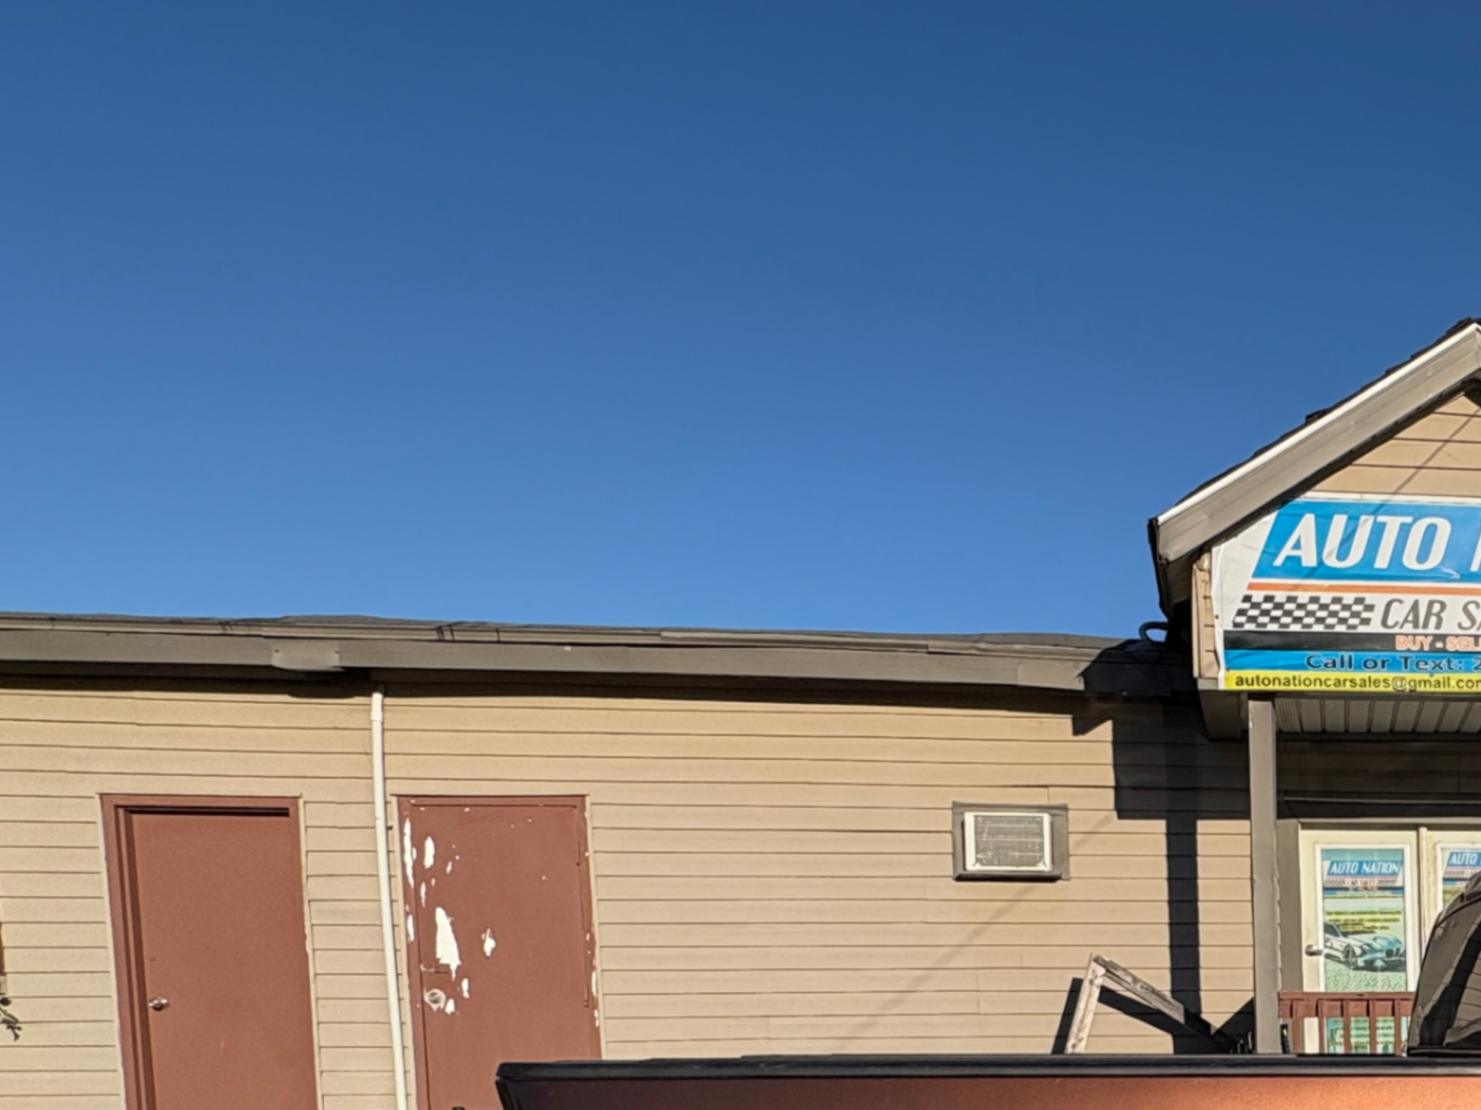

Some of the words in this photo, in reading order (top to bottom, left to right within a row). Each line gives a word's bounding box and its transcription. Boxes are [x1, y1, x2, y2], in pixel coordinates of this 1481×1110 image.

[1273, 513, 1452, 570] AUTO
[1380, 598, 1448, 631] CAR
[1394, 634, 1433, 651] BUY
[1306, 653, 1353, 671] Call
[1363, 656, 1390, 671] or
[1401, 655, 1464, 672] Text:
[1329, 861, 1358, 875] AUTO
[1360, 861, 1400, 875] NATION
